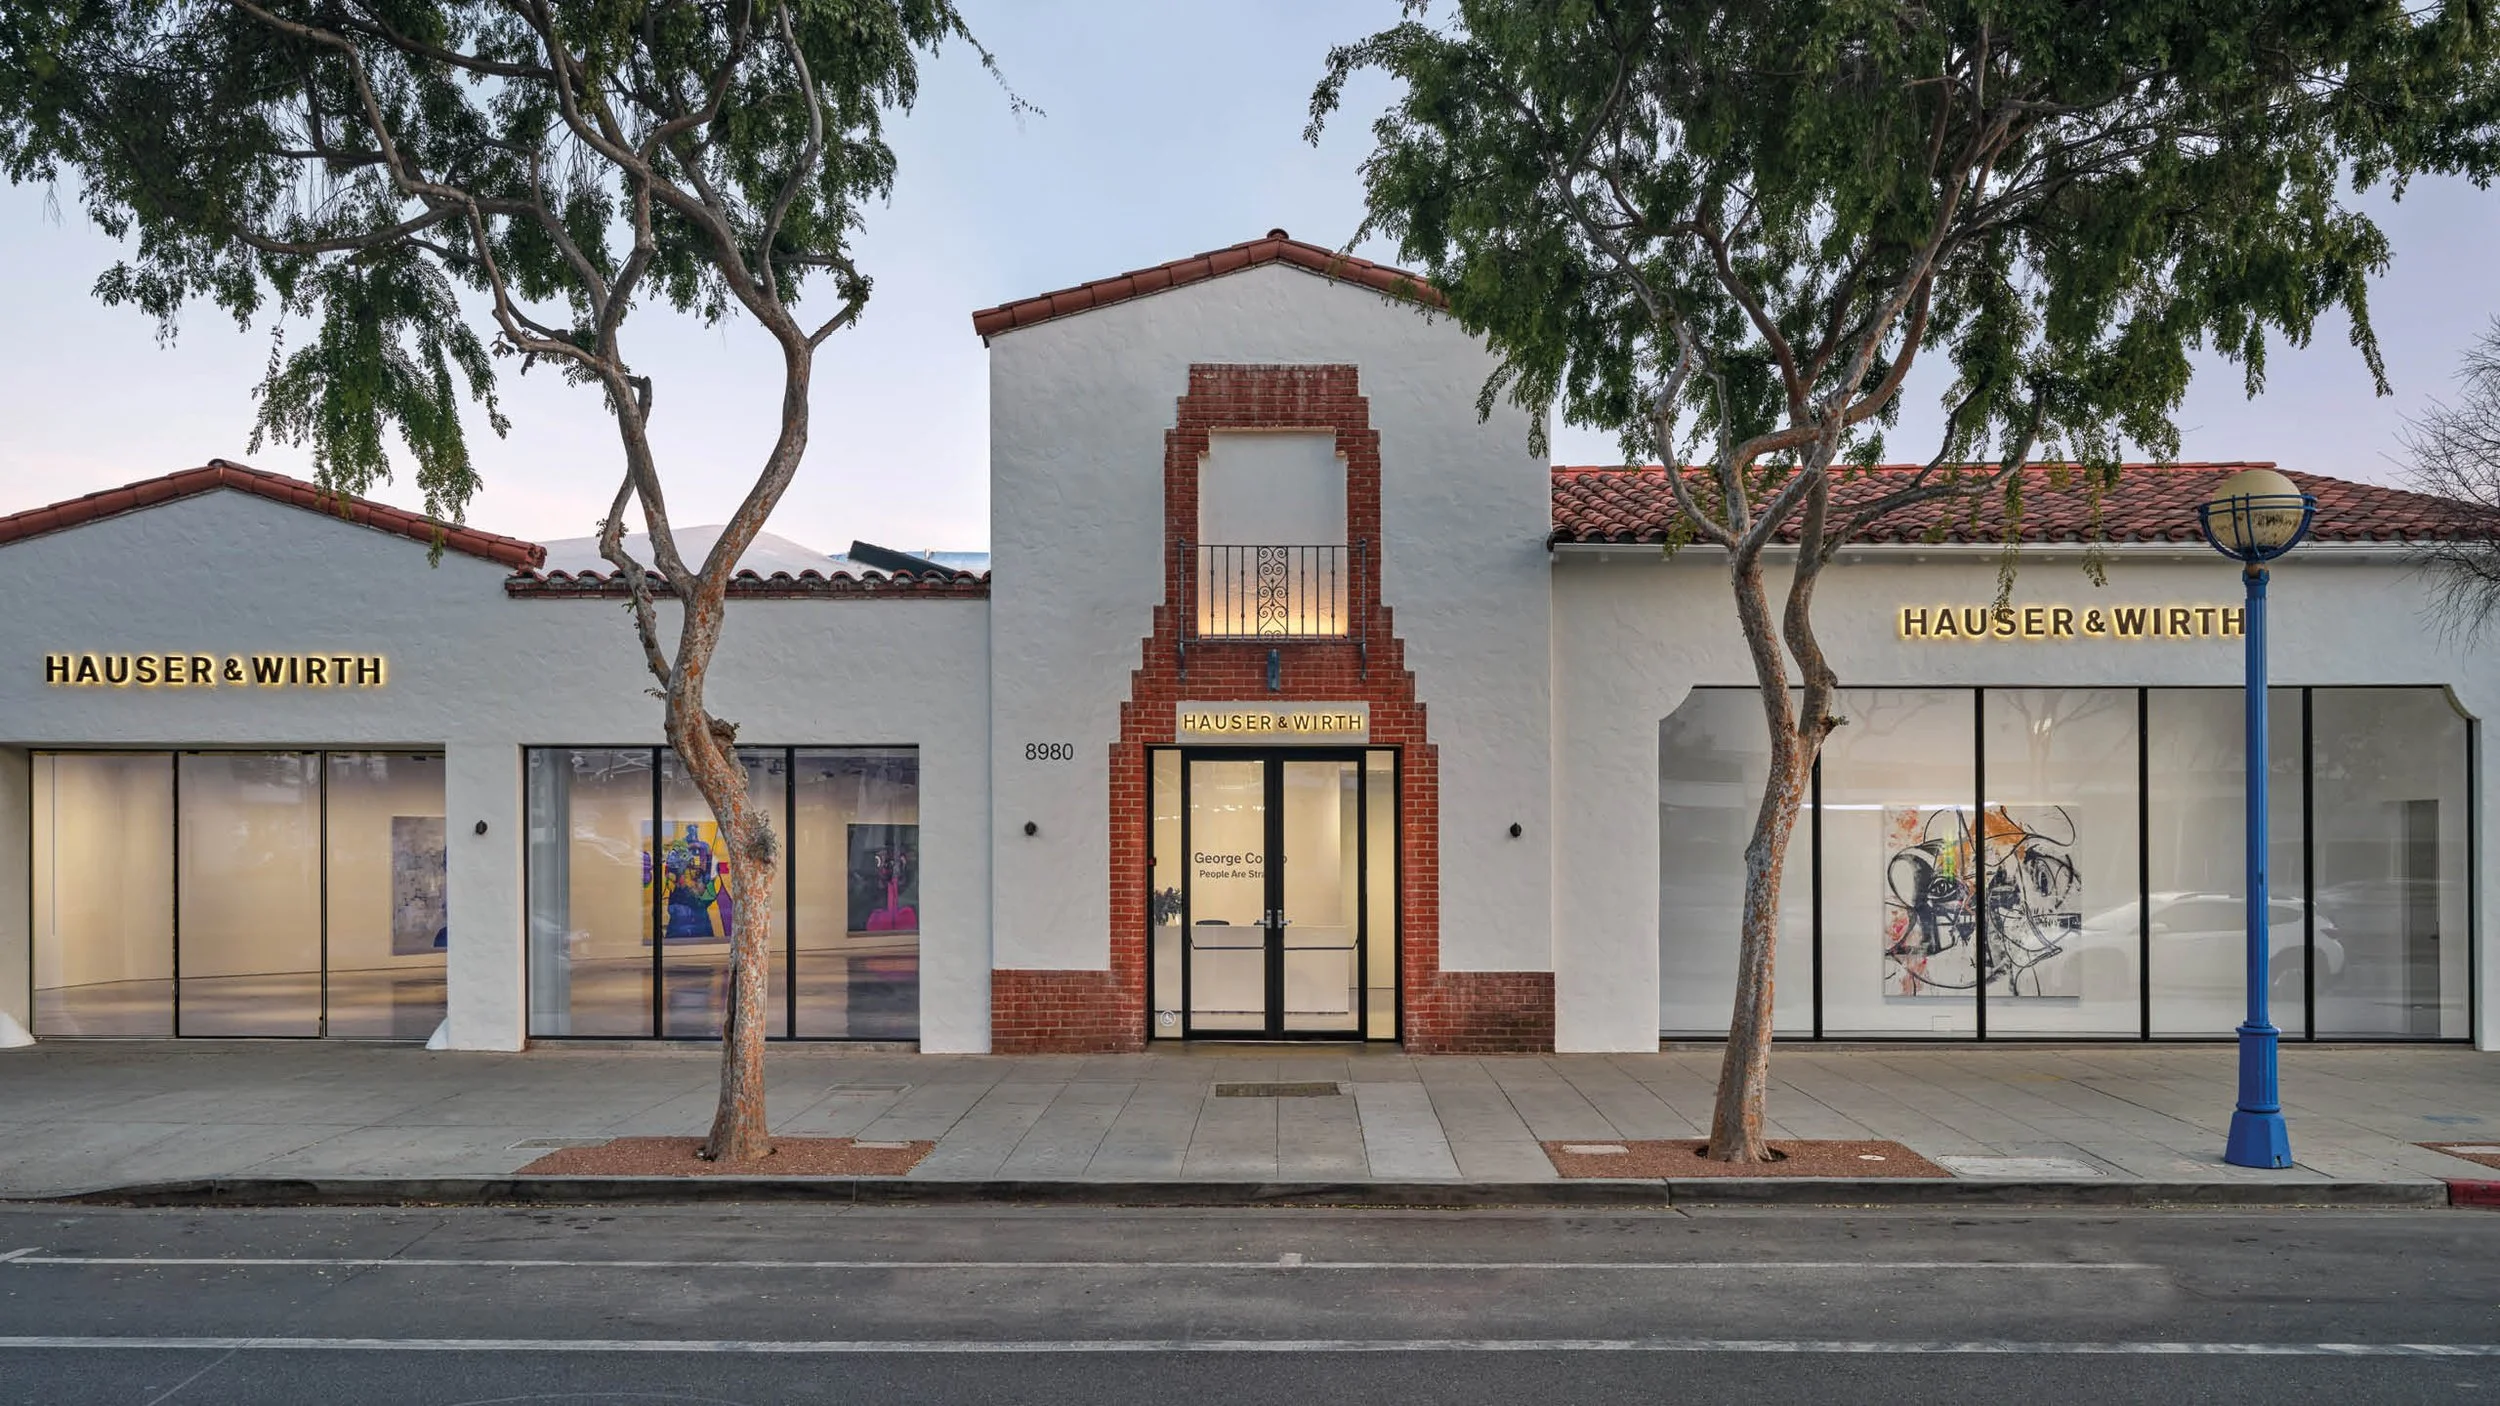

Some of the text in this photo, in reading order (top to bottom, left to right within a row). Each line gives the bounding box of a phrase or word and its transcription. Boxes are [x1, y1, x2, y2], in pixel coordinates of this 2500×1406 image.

[1904, 608, 2245, 635] HAUSER & WIRTH
[46, 655, 381, 684] HAUSER & WIRTH
[1184, 714, 1361, 730] HAUSER & WIRTH
[1025, 743, 1073, 760] 8980
[1194, 852, 1241, 866] George
[1199, 869, 1229, 879] People
[1231, 869, 1246, 878] Are
